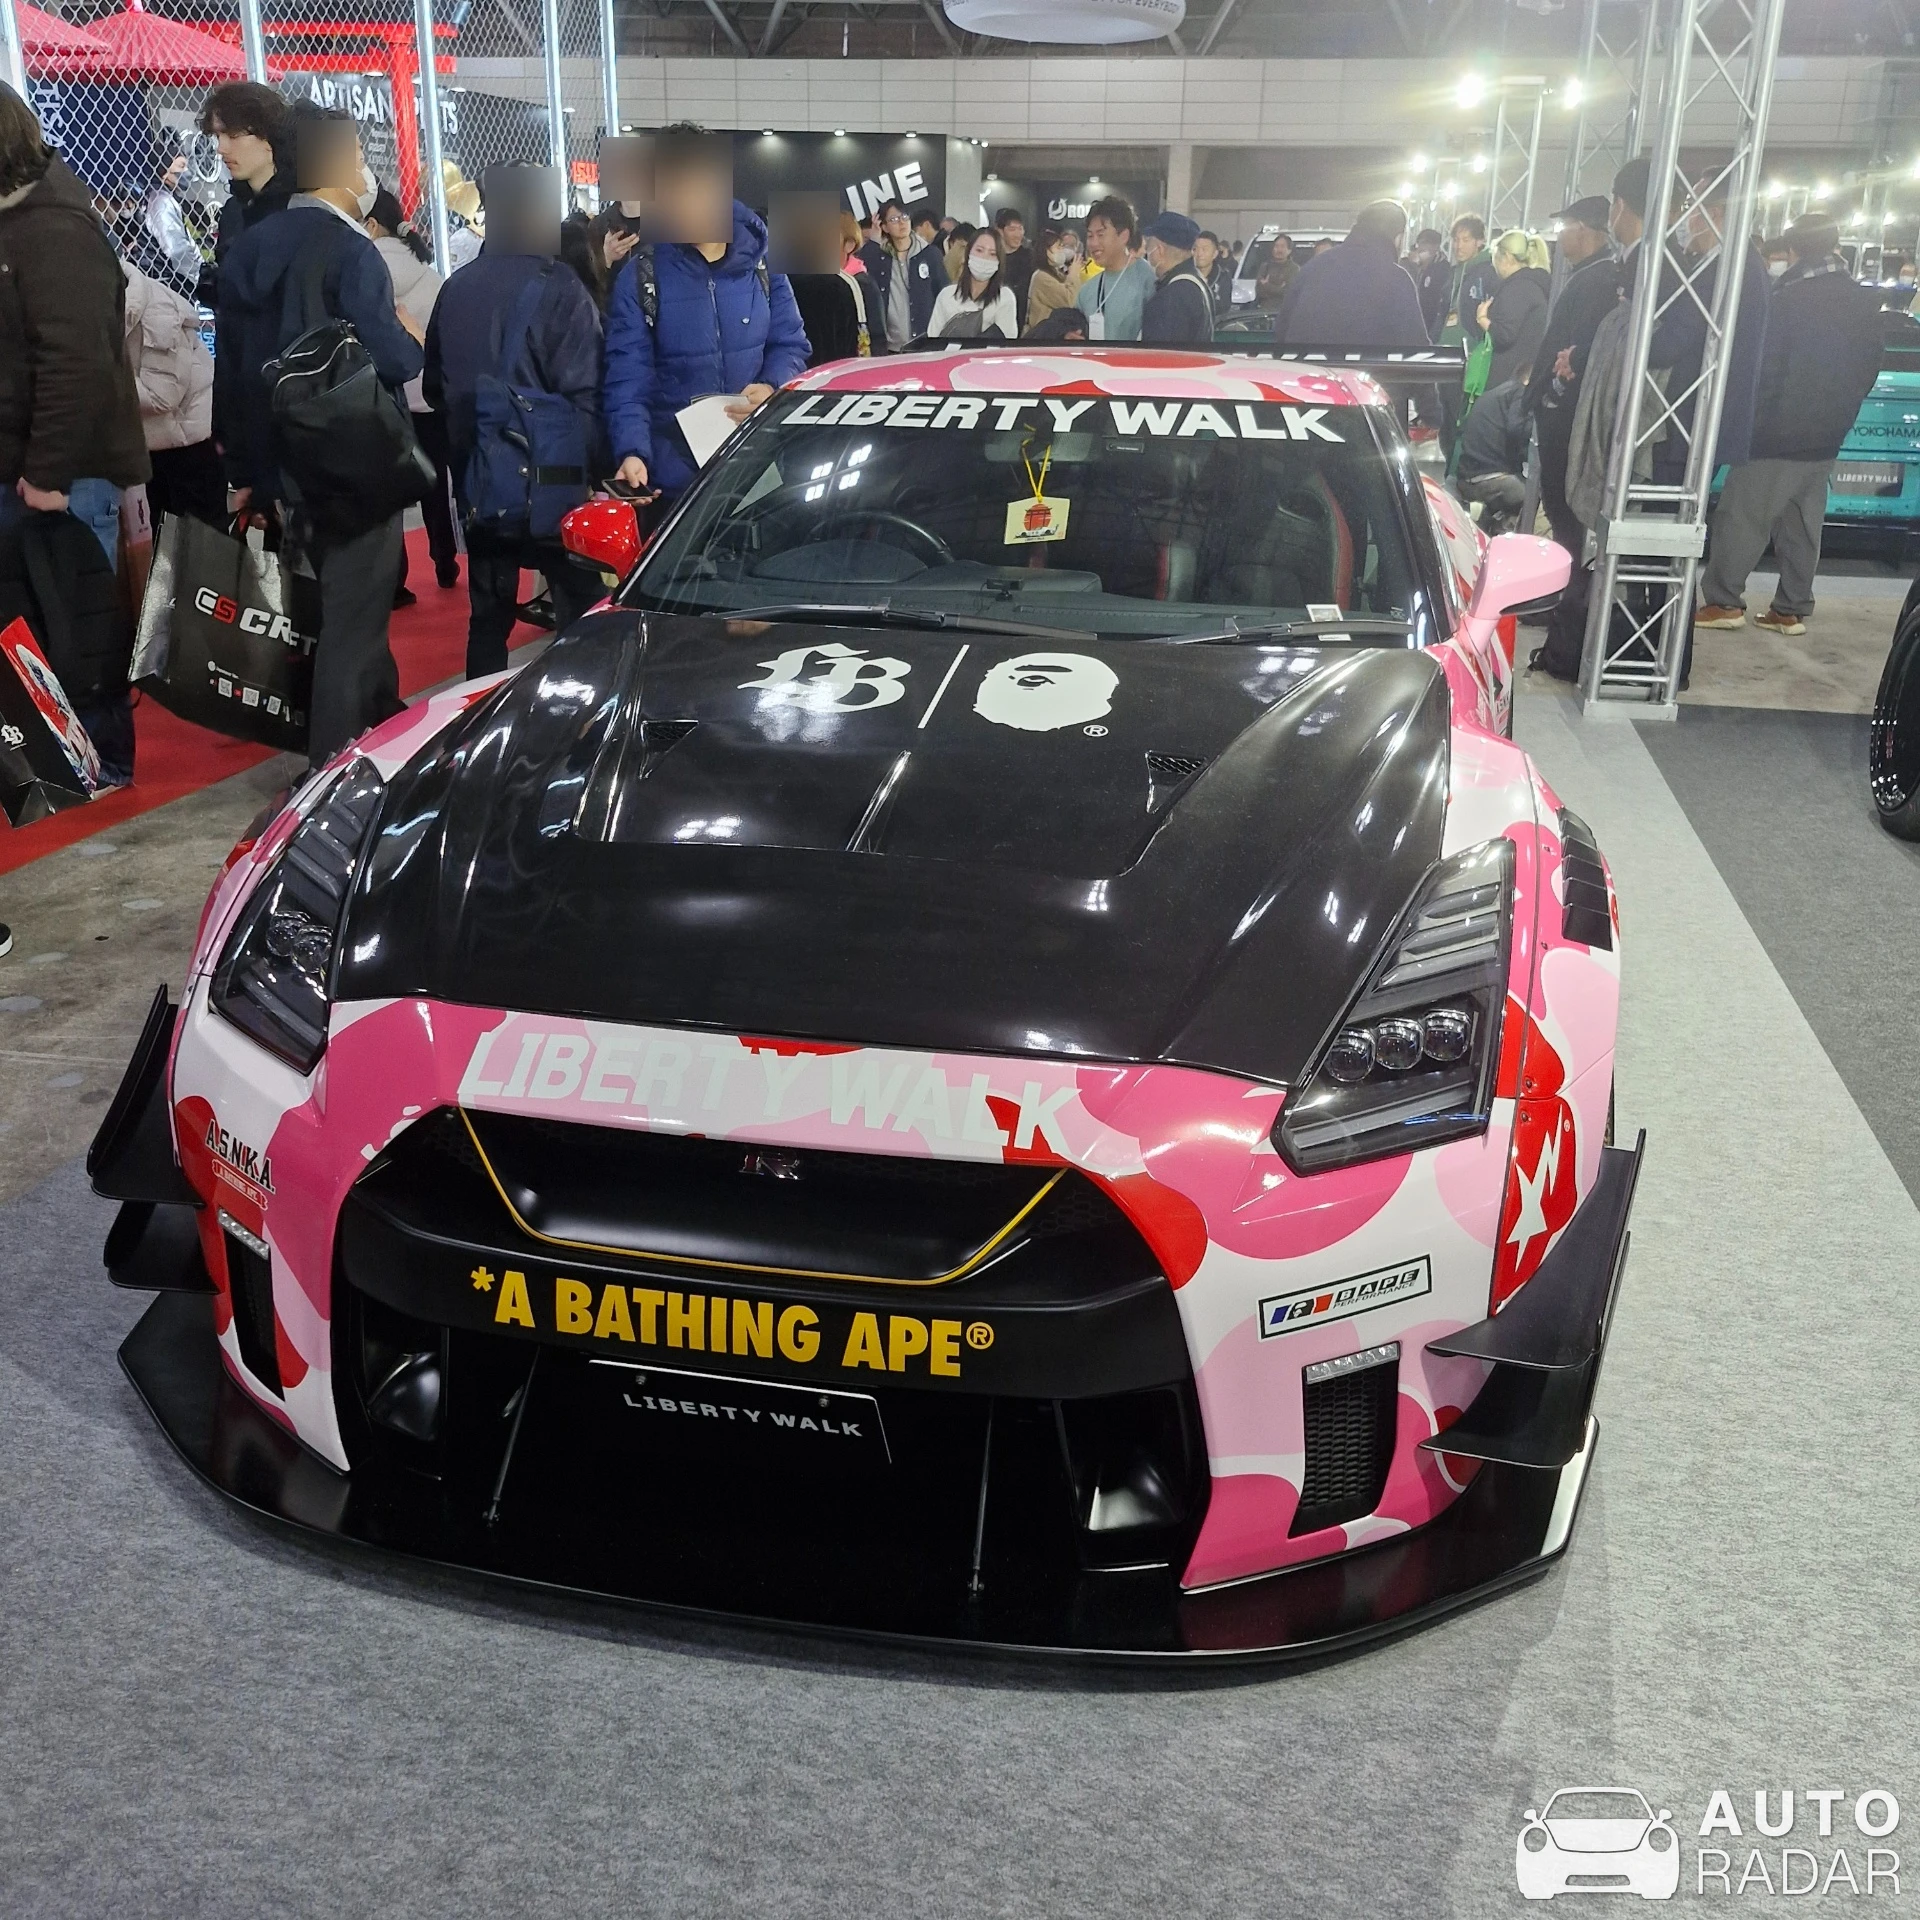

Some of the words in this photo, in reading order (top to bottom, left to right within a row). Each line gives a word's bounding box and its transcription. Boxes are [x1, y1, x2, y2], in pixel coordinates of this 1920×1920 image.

[781, 395, 1097, 432] LIBERTY
[1109, 401, 1346, 443] WALK
[1837, 474, 1874, 483] LIBERTY
[1875, 475, 1899, 484] WALK
[457, 1032, 817, 1118] LIBERTY
[830, 1056, 1083, 1155] WALK
[1333, 1281, 1416, 1309] PERFORMANCE
[1338, 1269, 1420, 1300] BAPE
[556, 1278, 821, 1363] BATHING
[623, 1394, 762, 1423] LIBERTY
[769, 1412, 863, 1437] WALK
